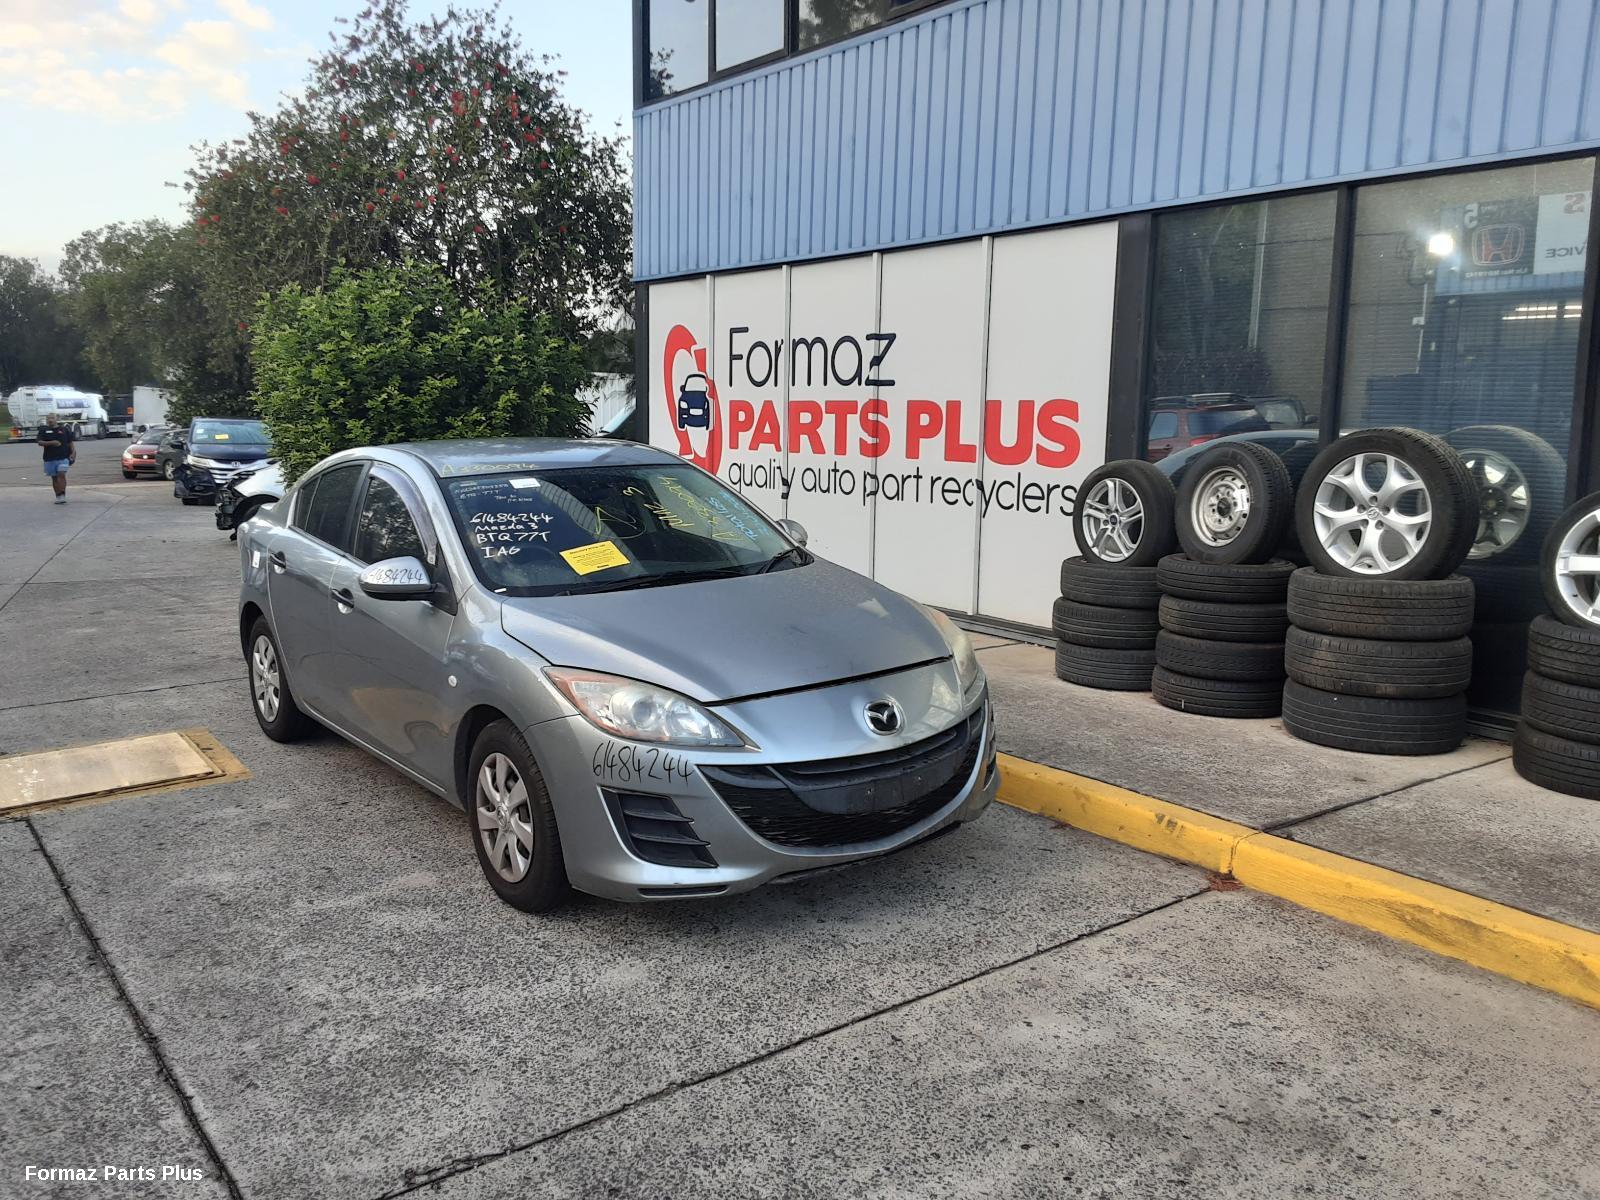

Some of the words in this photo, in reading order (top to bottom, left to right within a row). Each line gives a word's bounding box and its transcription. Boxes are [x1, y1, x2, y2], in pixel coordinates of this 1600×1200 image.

[729, 326, 896, 388] Formaz
[728, 399, 891, 458] PARTS
[905, 399, 1081, 469] PLUS
[801, 461, 856, 496] auto
[864, 466, 923, 507] part
[930, 471, 1078, 519] recyclers
[470, 512, 554, 525] 61484244
[476, 532, 513, 544] BTQ
[514, 531, 551, 542] 77T
[528, 522, 538, 531] 3
[593, 740, 695, 787] 61484244
